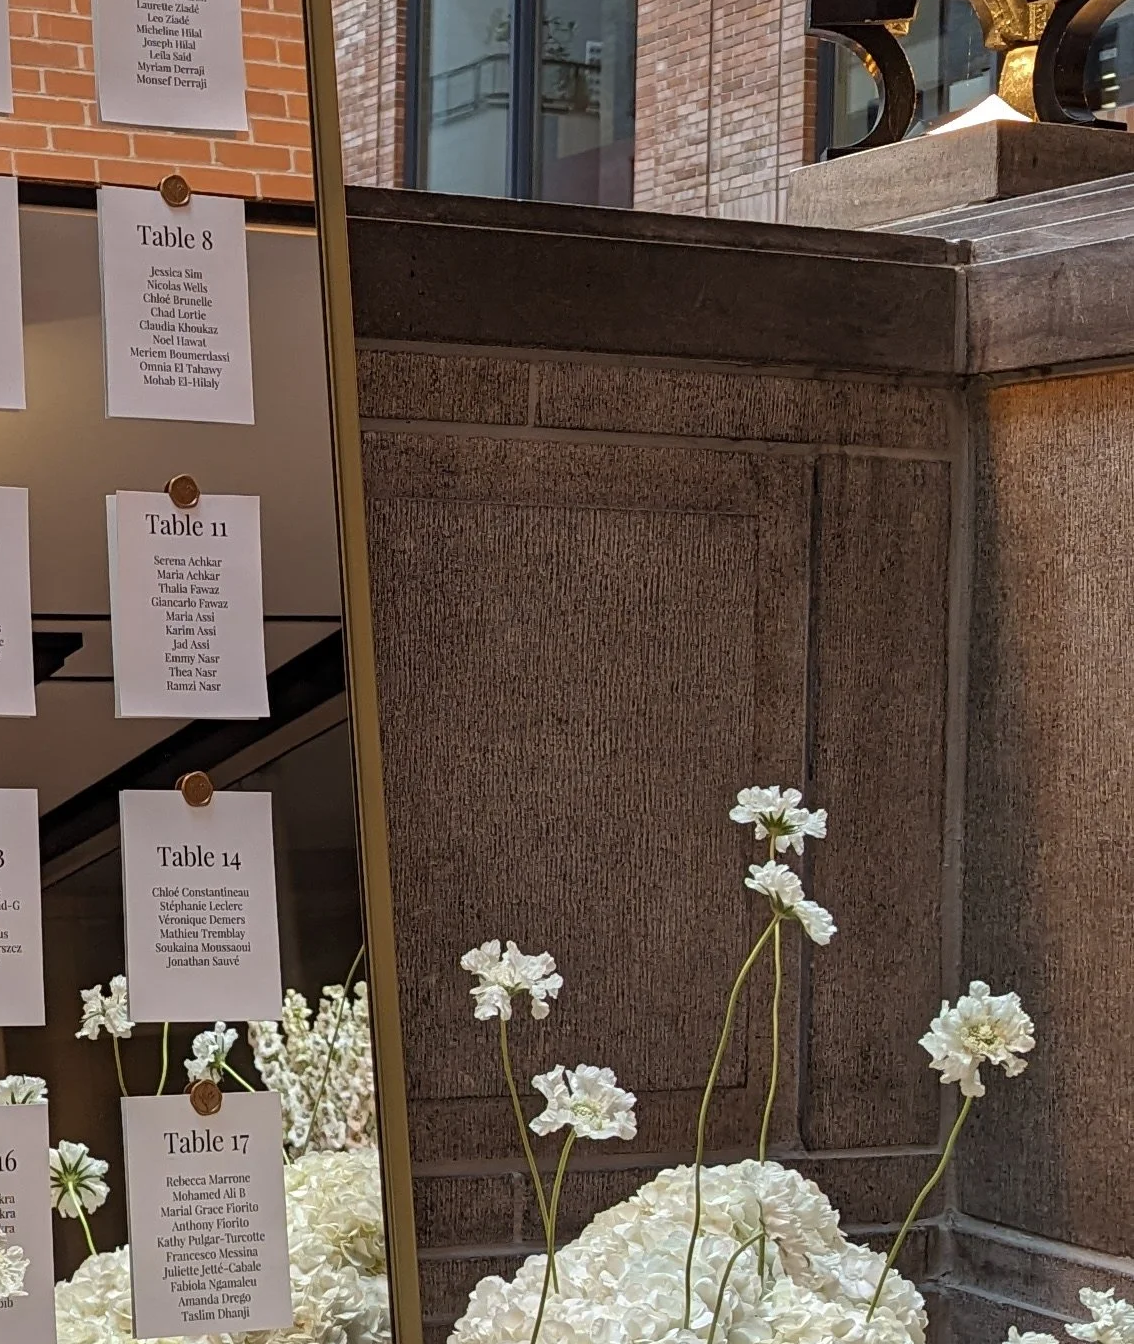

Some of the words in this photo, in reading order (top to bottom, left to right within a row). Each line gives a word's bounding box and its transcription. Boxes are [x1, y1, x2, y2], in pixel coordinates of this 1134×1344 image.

[148, 13, 163, 23] Leo
[165, 14, 190, 25] Ziadé
[174, 77, 207, 90] Derraji
[137, 224, 195, 249] Table
[202, 230, 213, 250] 8
[147, 280, 181, 291] Nicolas
[183, 282, 208, 293] Wells
[143, 293, 171, 304] Chloé
[174, 295, 212, 307] Brunelle
[151, 307, 175, 318] Chad
[178, 309, 206, 320] Lortie
[145, 513, 203, 536] Table
[210, 522, 228, 537] 11
[154, 555, 186, 566] Serena
[188, 556, 222, 567] Achkar
[157, 569, 184, 580] Maria
[186, 570, 220, 581] Achkar
[166, 625, 195, 635] Karim
[197, 626, 216, 636] Assi
[157, 845, 215, 867] Table
[222, 852, 241, 870] 14
[160, 900, 207, 913] Stéphanie
[209, 900, 243, 911] Leclerc
[160, 928, 198, 938] Mathieu
[201, 928, 245, 940] Tremblay
[166, 956, 210, 968] Jonathan
[212, 955, 240, 966] Sauvé
[164, 1129, 224, 1154] Table
[231, 1134, 249, 1154] 17
[166, 1175, 206, 1187] Rebecca
[209, 1174, 250, 1185] Marrone
[172, 1220, 214, 1232] Anthony
[216, 1217, 249, 1229] Fiorito
[178, 1294, 219, 1307] Amanda
[222, 1293, 251, 1304] Drego
[181, 1309, 215, 1322] Taslim
[218, 1306, 250, 1320] Dhanji
